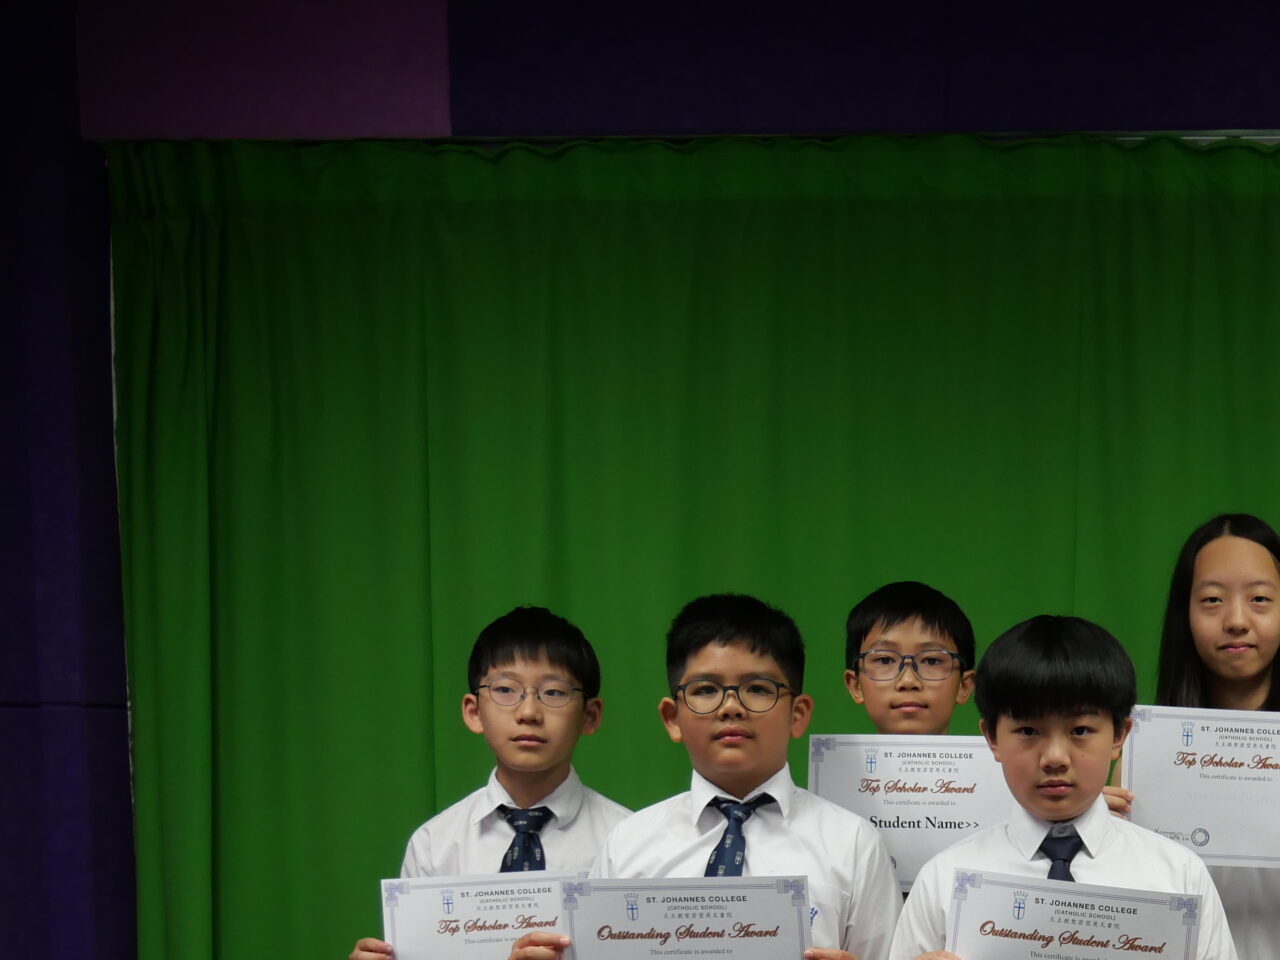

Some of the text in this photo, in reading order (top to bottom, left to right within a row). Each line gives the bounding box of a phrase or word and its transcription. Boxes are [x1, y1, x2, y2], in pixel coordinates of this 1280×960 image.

[1174, 751, 1197, 769] Top
[1200, 753, 1244, 769] Scholar
[858, 778, 977, 796] Top Scholar Award
[870, 816, 979, 829] Student Name>>
[1050, 900, 1095, 910] JOHANNES
[1099, 905, 1137, 915] COLLEGE
[1055, 909, 1087, 918] (CATHOLIC
[597, 922, 780, 945] Outstanding Student Award
[980, 921, 1166, 953] Outstanding Student Award
[1044, 952, 1073, 960] certificate
